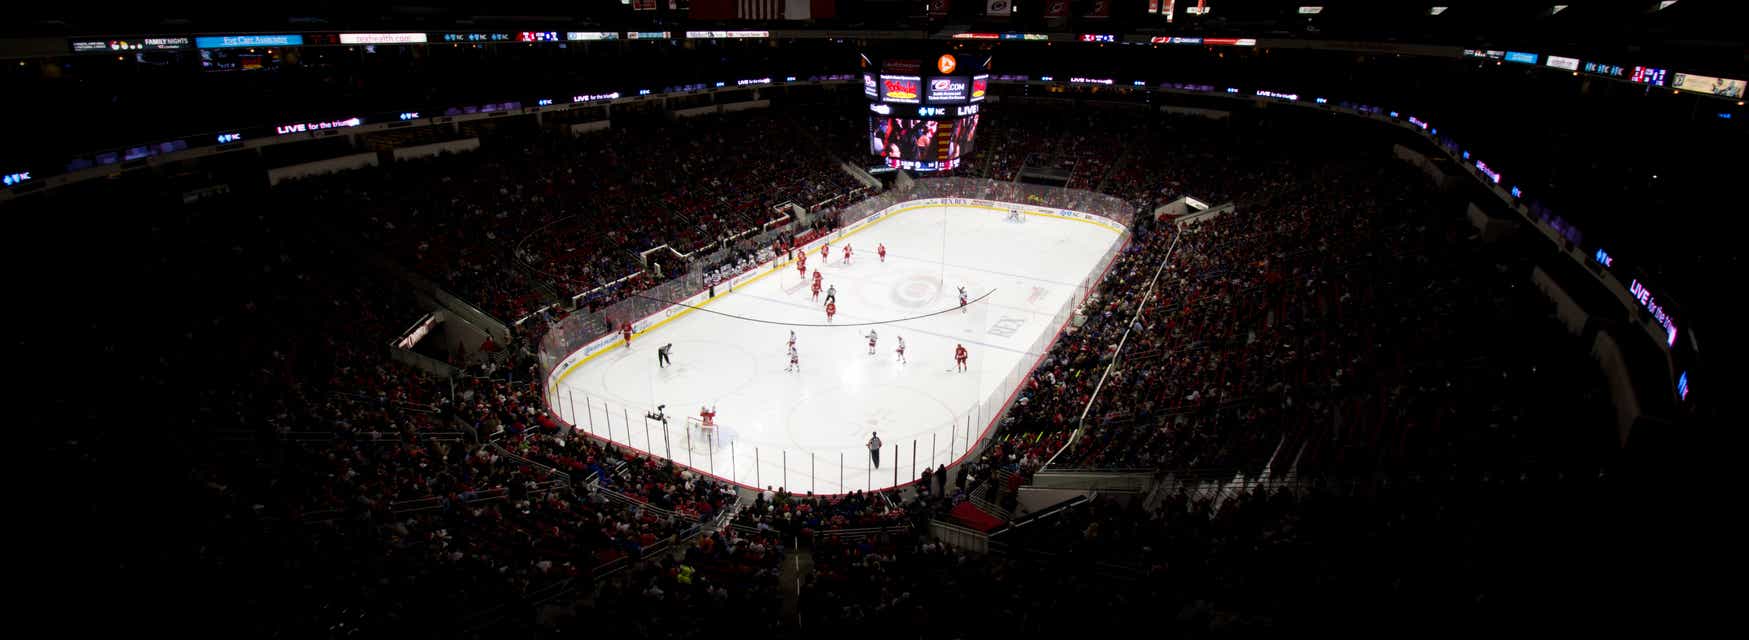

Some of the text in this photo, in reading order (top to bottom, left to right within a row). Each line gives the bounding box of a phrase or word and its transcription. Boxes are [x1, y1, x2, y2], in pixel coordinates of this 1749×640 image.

[145, 37, 188, 46] FAMILY NIGHTS
[277, 123, 306, 134] LIVE
[308, 122, 319, 130] for
[1630, 279, 1650, 306] LIVE
